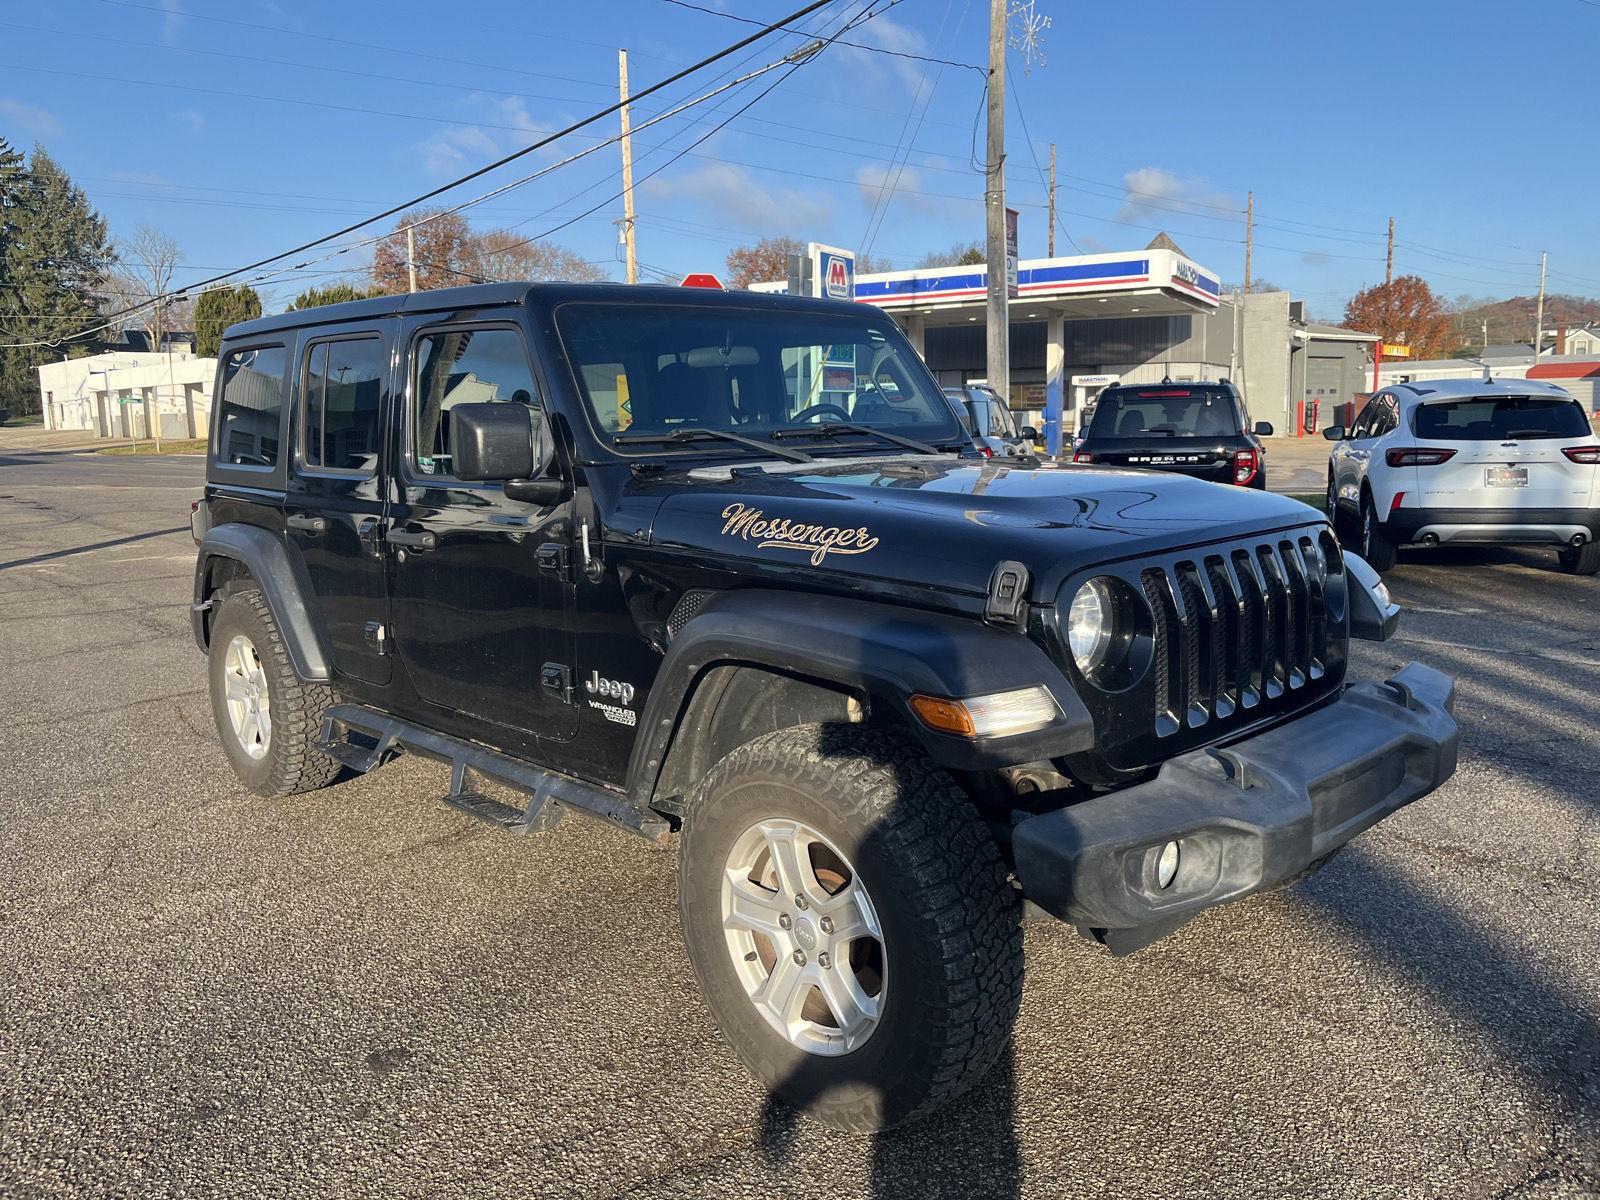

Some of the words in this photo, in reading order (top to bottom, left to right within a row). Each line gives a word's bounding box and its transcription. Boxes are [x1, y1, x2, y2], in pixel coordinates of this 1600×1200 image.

[722, 502, 879, 566] Messenger
[585, 670, 634, 705] Jeep
[588, 699, 636, 717] WRANGLER
